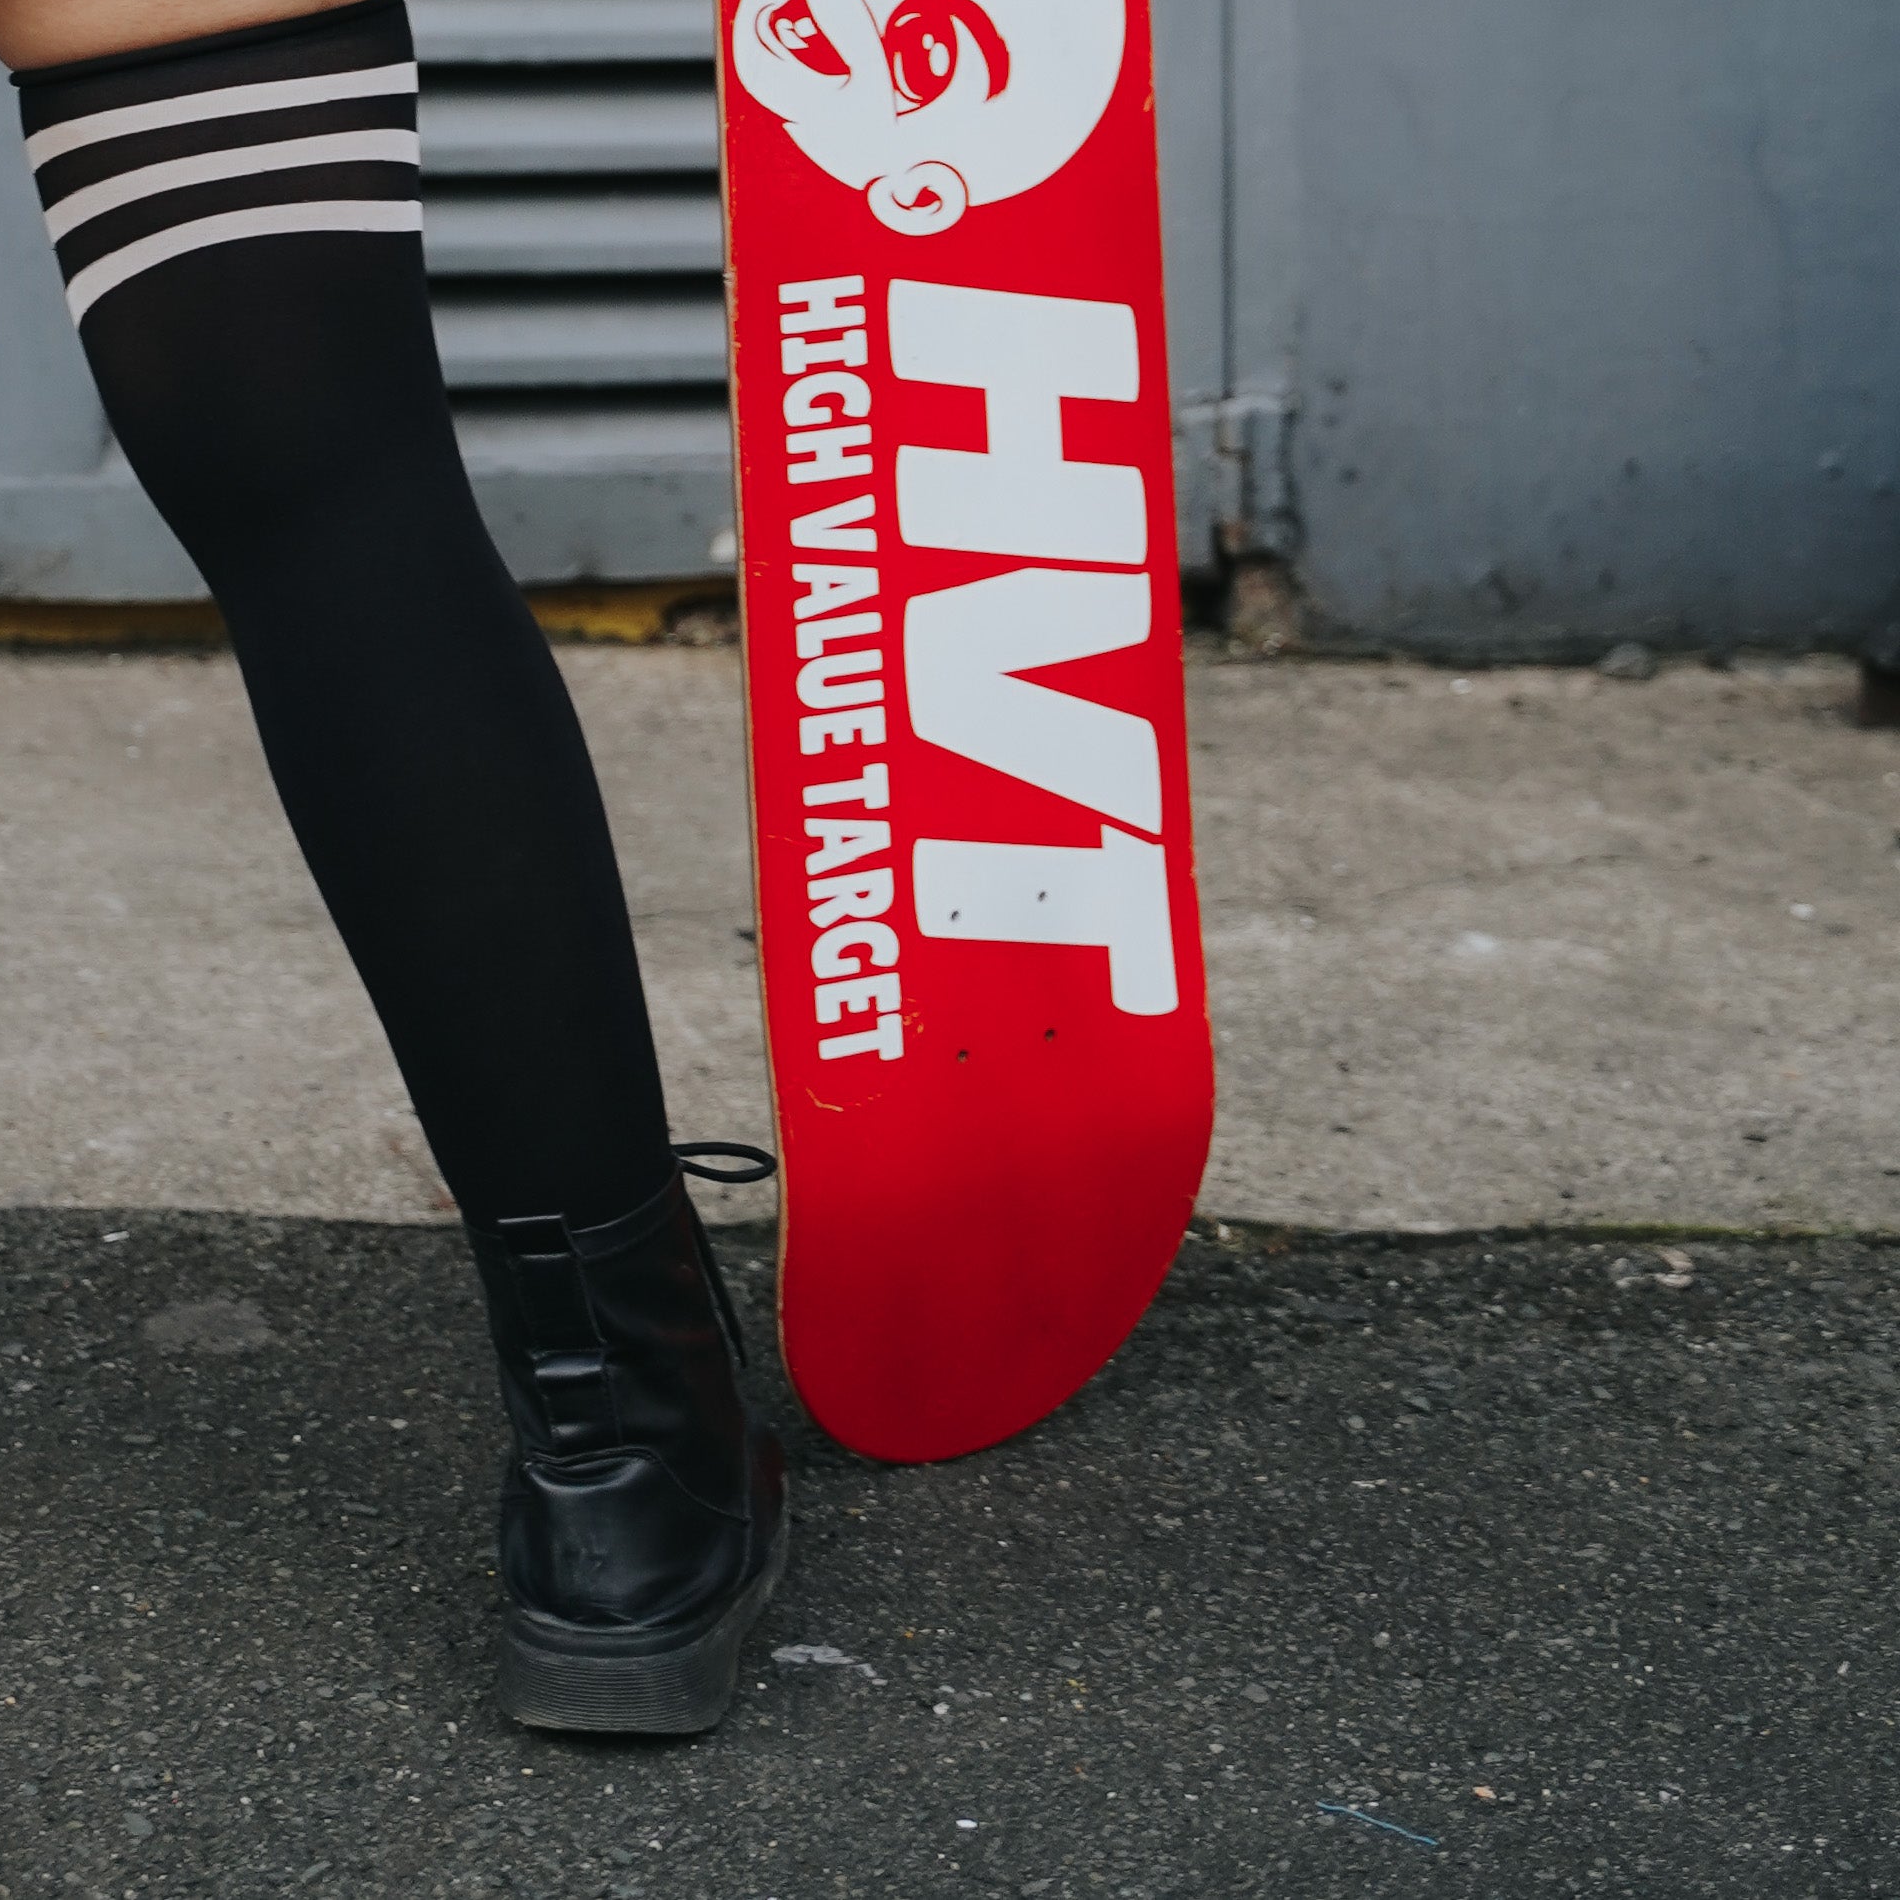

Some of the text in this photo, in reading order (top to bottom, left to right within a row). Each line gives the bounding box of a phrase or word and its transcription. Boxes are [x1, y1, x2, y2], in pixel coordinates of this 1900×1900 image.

[777, 274, 905, 1062] HIGH VALUE TARGET
[886, 278, 1180, 1016] HVT
